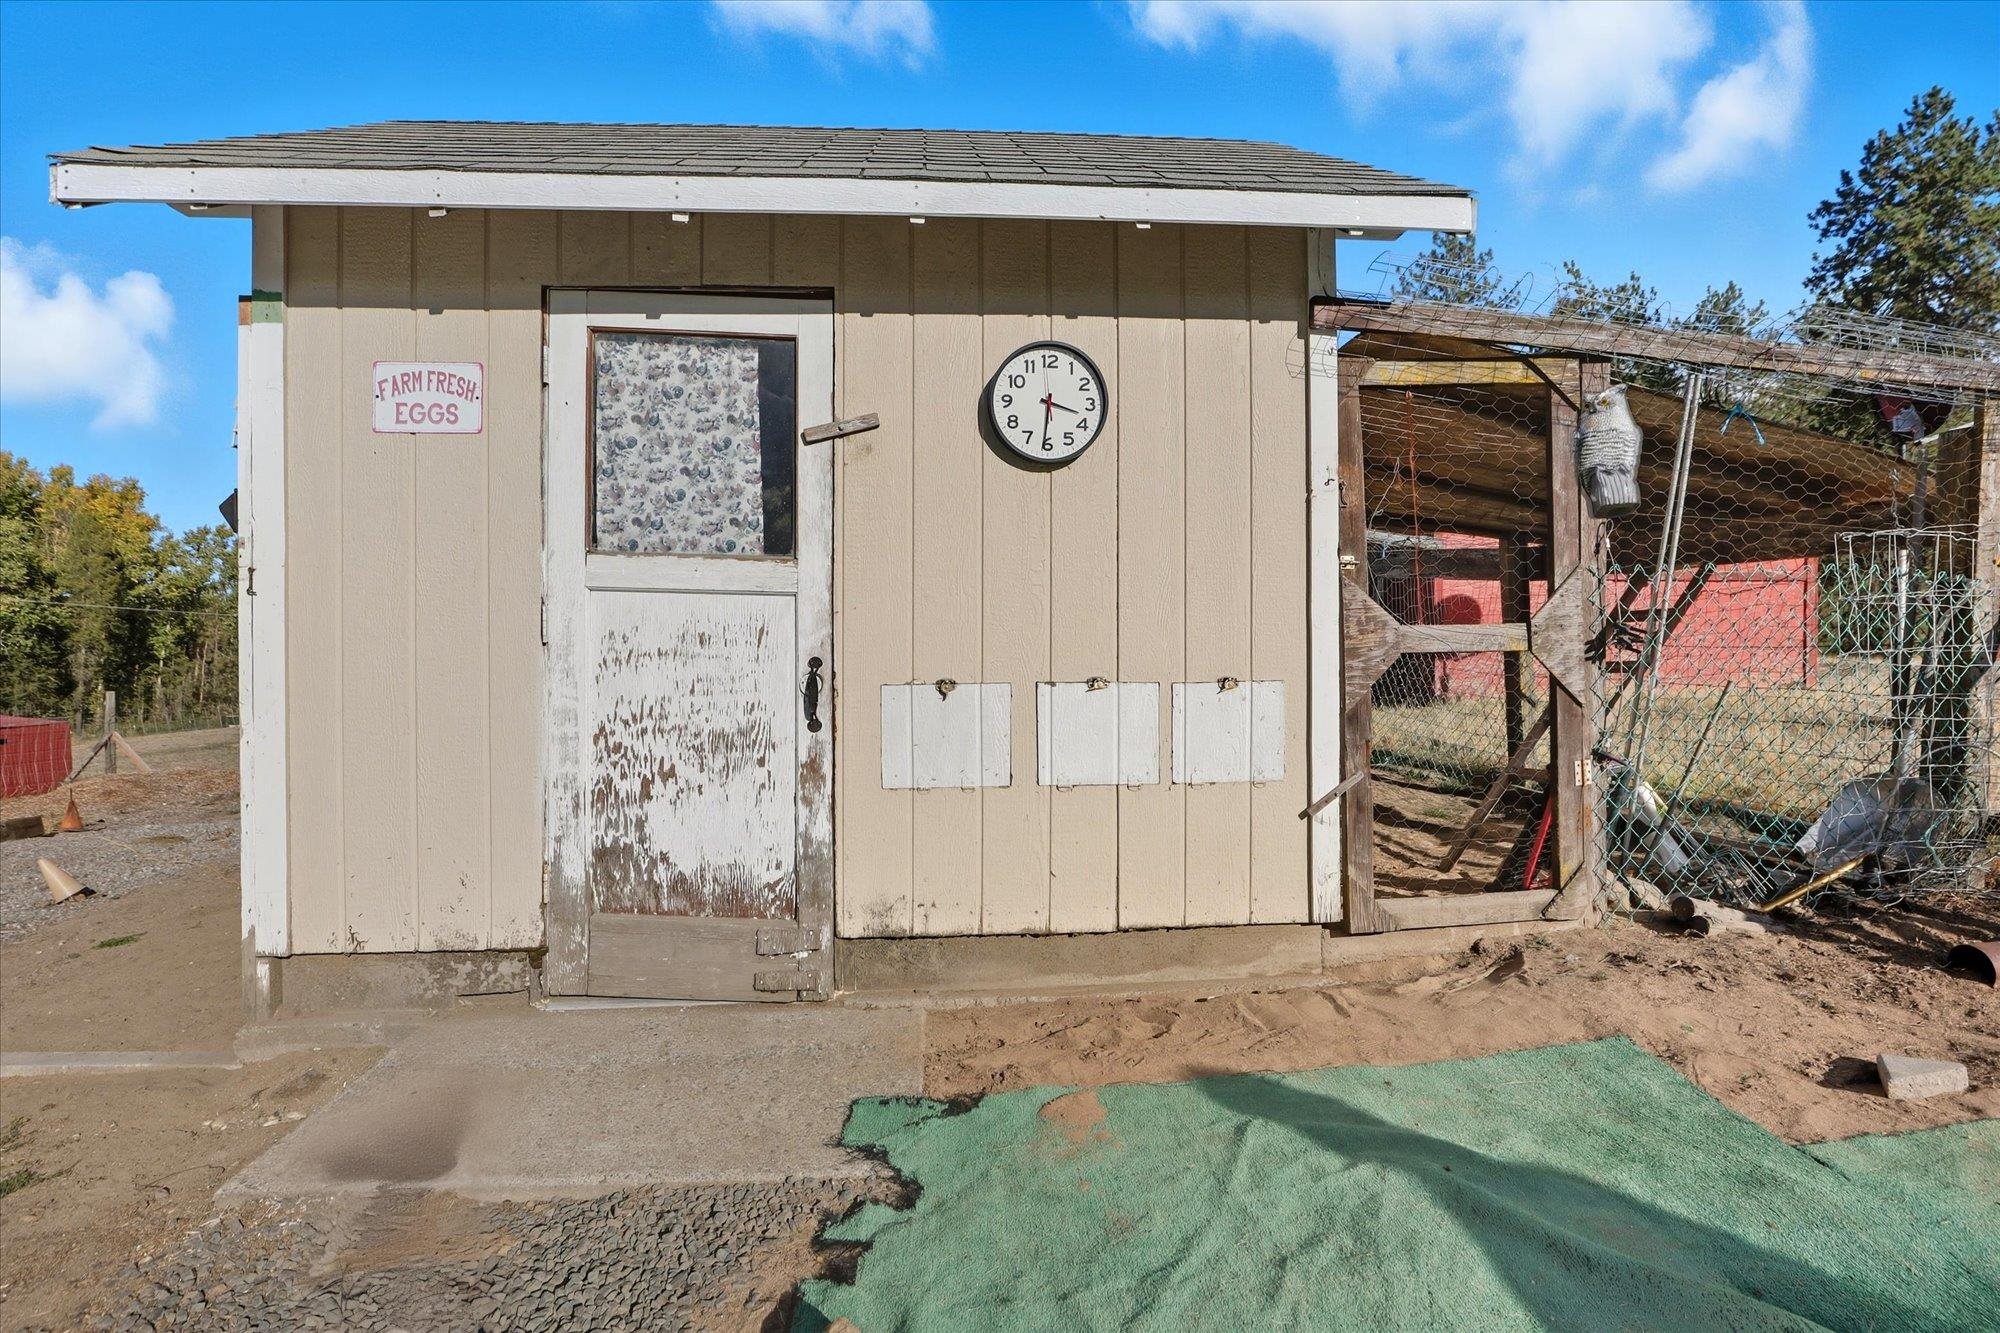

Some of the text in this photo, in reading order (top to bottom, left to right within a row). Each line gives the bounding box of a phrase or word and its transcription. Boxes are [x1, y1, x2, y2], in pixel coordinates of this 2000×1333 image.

[1024, 359, 1035, 373] 11
[1041, 354, 1059, 369] 12
[1068, 361, 1074, 375] 1
[377, 370, 477, 403] FARM FRESH
[1008, 374, 1026, 389] 10
[1079, 377, 1090, 391] 2
[1001, 394, 1013, 408] 9
[1085, 397, 1096, 411] 3
[395, 402, 459, 425] EGGS
[1007, 414, 1019, 429] 8
[1076, 417, 1089, 431] 4
[1022, 430, 1034, 444] 7
[1042, 437, 1053, 451] 6
[1063, 432, 1074, 446] 5
